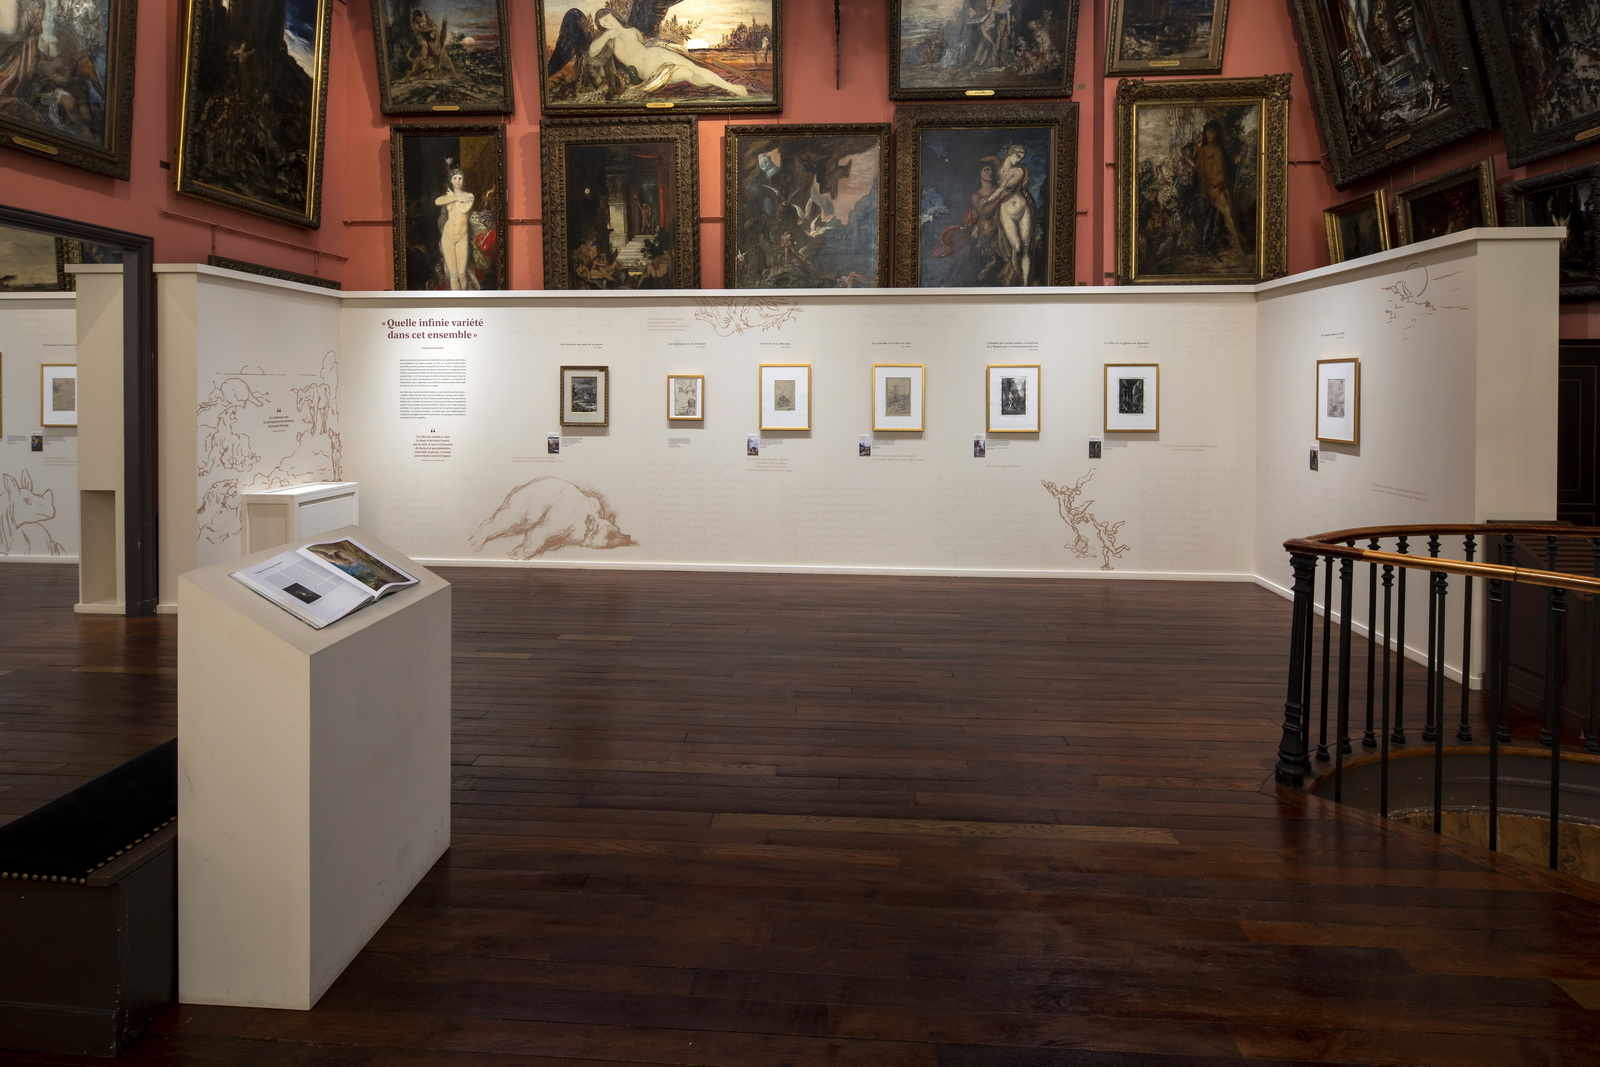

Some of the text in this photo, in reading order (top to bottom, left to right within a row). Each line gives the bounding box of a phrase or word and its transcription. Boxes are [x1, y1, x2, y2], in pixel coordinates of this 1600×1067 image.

[419, 318, 450, 327] infinie
[452, 318, 484, 327] variété
[388, 330, 410, 339] dans
[412, 331, 425, 339] cet
